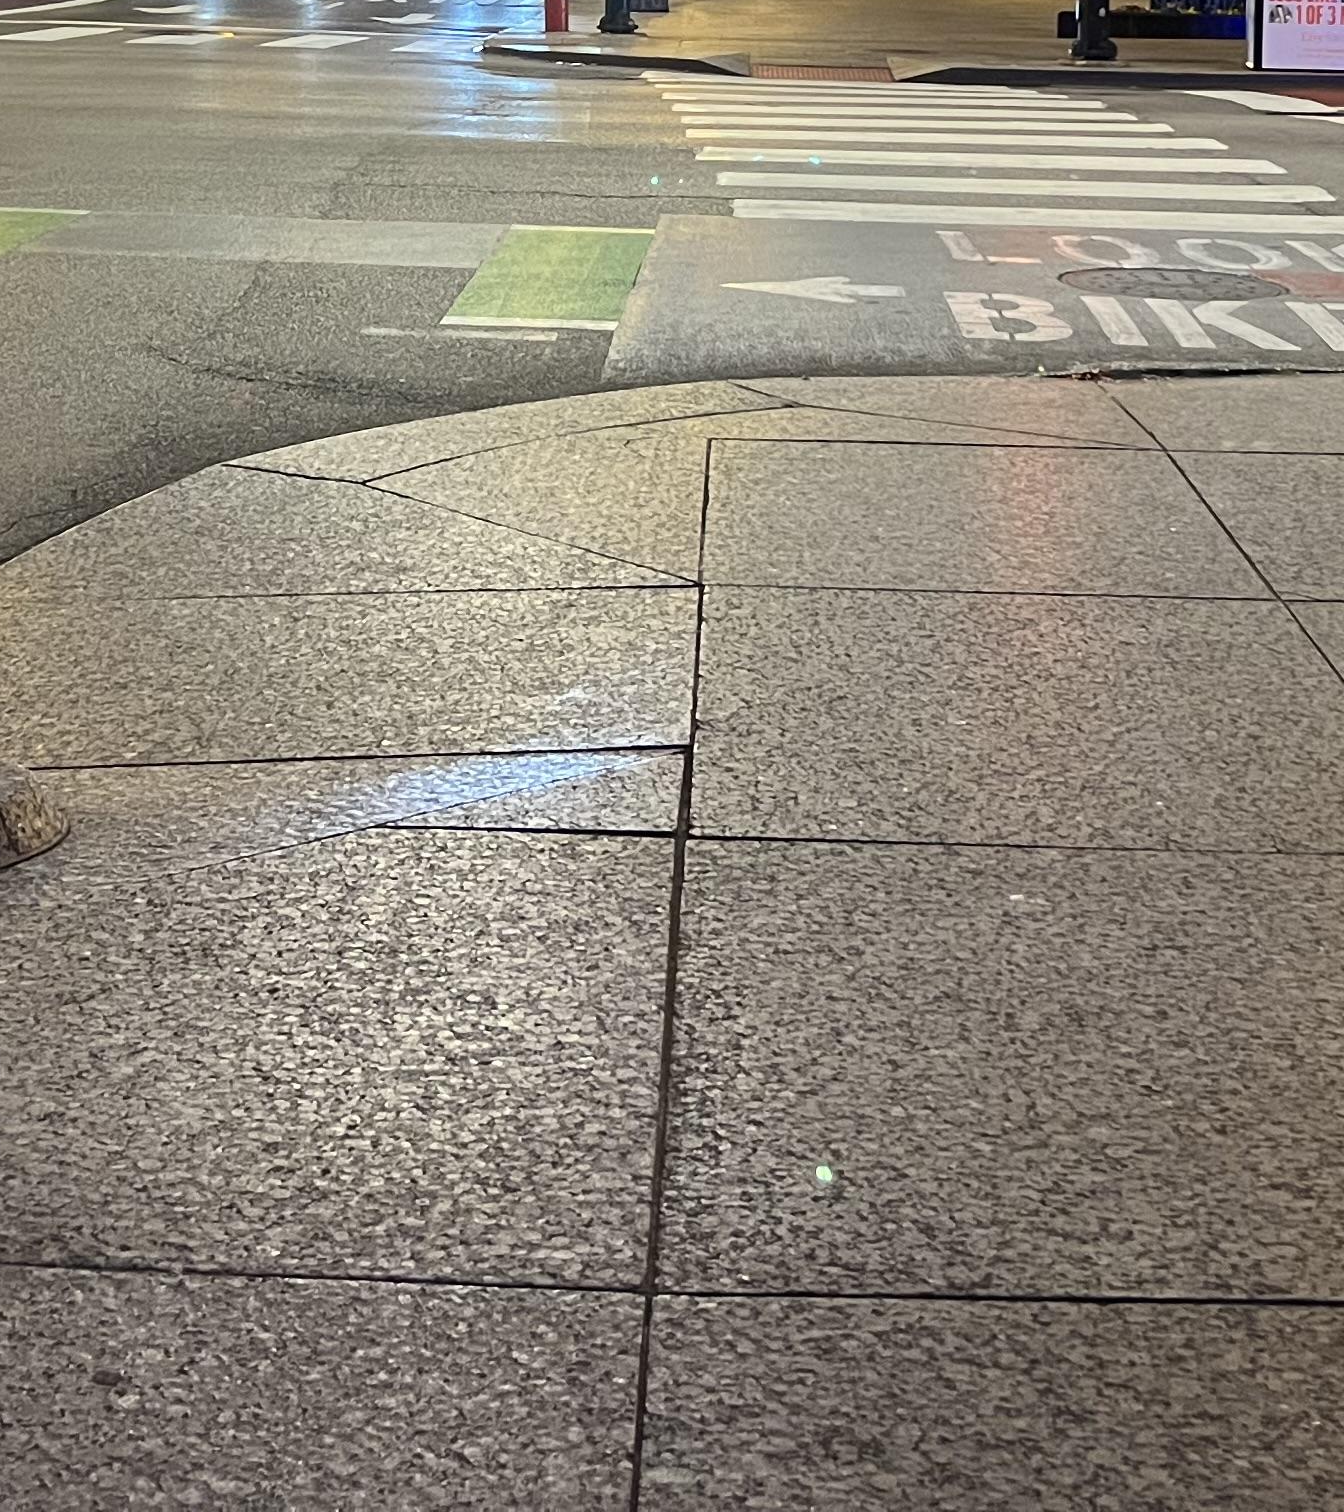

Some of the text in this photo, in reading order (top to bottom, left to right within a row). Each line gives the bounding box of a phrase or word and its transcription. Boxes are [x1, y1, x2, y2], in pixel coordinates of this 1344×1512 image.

[1296, 5, 1302, 25] 1
[1306, 5, 1324, 25] OF
[1327, 6, 1336, 25] 3
